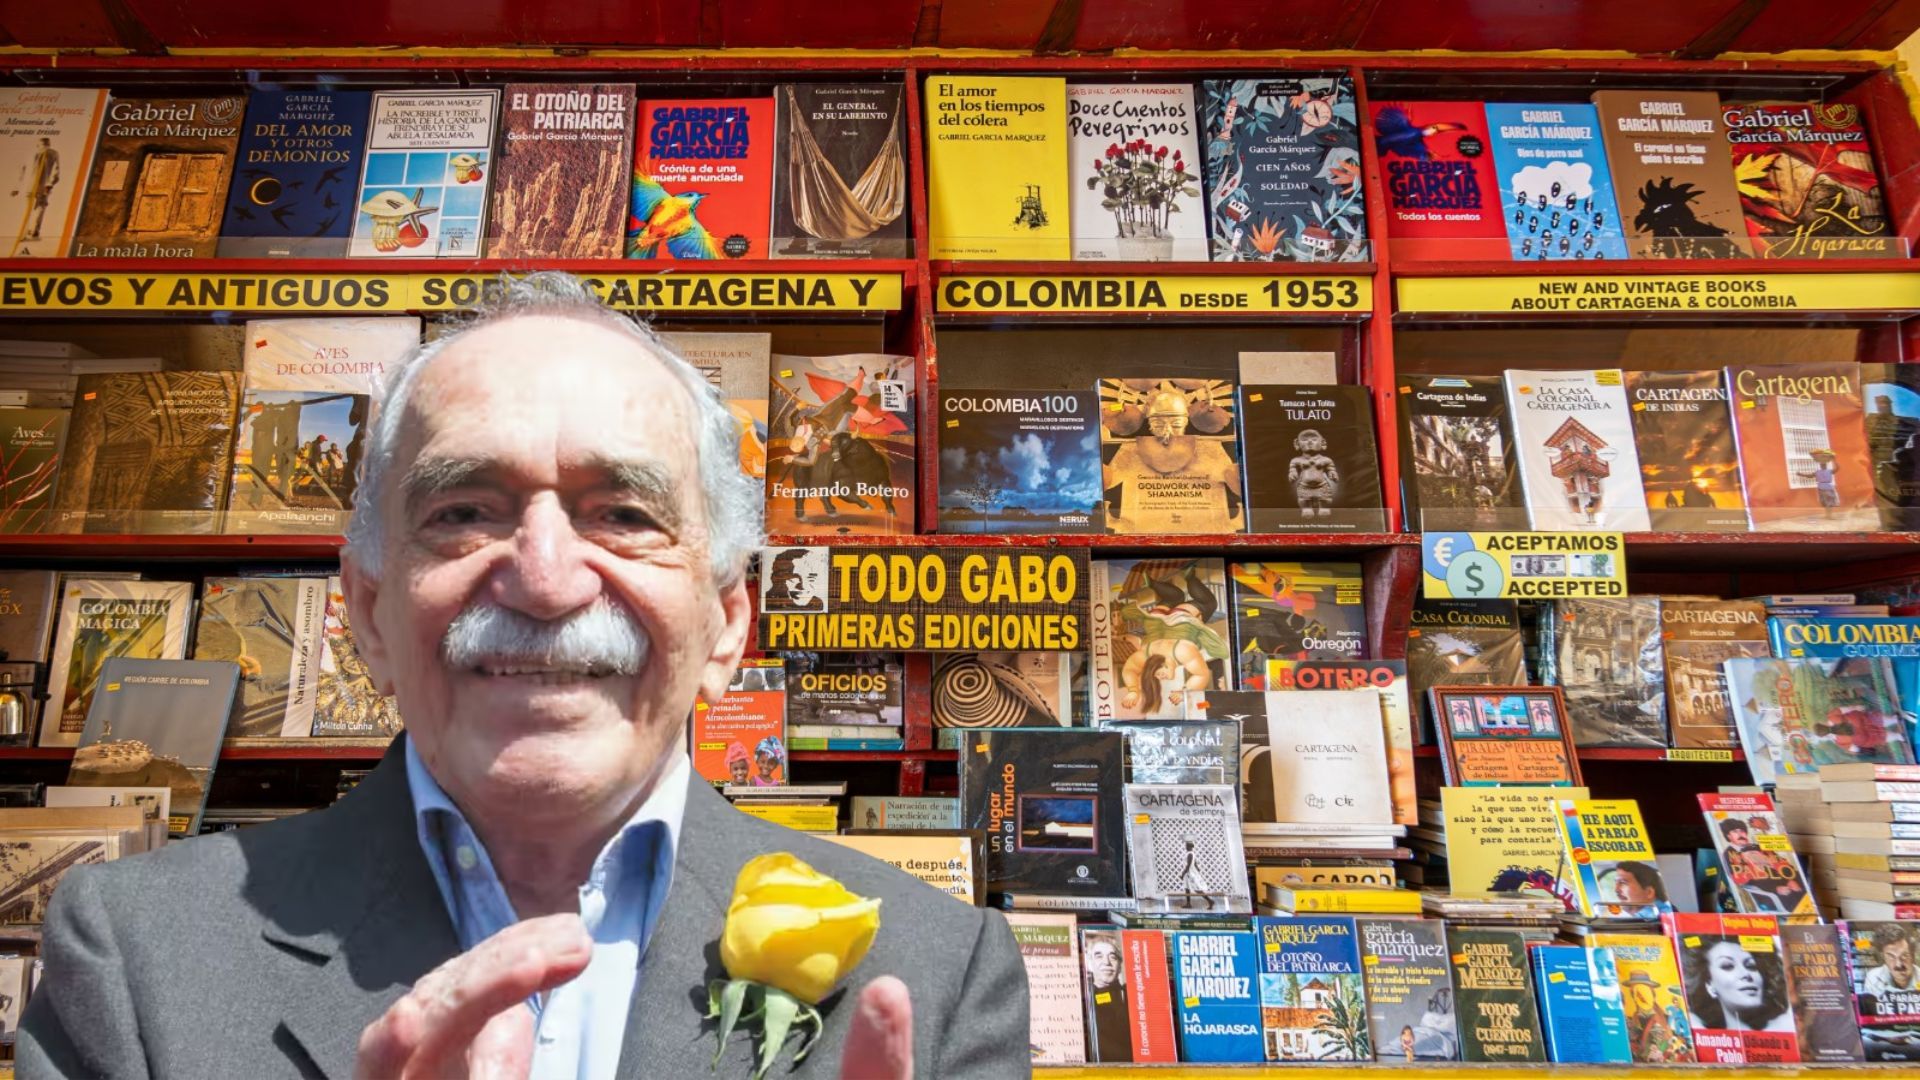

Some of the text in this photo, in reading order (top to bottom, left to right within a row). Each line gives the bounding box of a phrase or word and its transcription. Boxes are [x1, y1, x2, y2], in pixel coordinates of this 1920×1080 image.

[939, 84, 997, 97] El amor
[512, 90, 625, 111] EL OTOÑO DEL
[822, 102, 878, 111] EL GENERAL
[938, 100, 1045, 115] en los tiempos
[110, 104, 195, 121] Gabriel
[652, 107, 750, 122] GABRIEL
[1069, 99, 1187, 118] Doce Cuentos
[1640, 102, 1686, 116] GABRIEL
[533, 112, 625, 130] PATRIARCA
[812, 112, 888, 120] EN SU LABERINTO
[938, 113, 1008, 126] del cólera
[1521, 110, 1565, 123] GABRIEL
[1723, 109, 1812, 128] Gabriel
[106, 124, 237, 139] García Márquez
[255, 125, 354, 137] DEL AMOR
[650, 117, 750, 147] GARCÍA
[1069, 118, 1189, 144] Peregrinos
[1618, 117, 1714, 133] GARCÍA MÁRQUEZ
[1266, 136, 1298, 144] Gabriel
[1500, 125, 1593, 141] GARCÍA MÁRQUEZ
[1727, 129, 1863, 145] García Márquez
[271, 138, 334, 149] Y OTROS
[248, 150, 350, 163] DEMONIOS
[650, 144, 748, 159] MÁRQUEZ
[659, 164, 736, 174] Crónica de una
[1256, 162, 1311, 172] CIEN AÑOS
[1387, 161, 1477, 175] GABRIEL
[650, 173, 744, 183] muerte anunciada
[1389, 170, 1481, 198] GARCÍA
[1260, 182, 1309, 191] SOLEDAD
[1397, 212, 1481, 221] Todos los cuentos
[1815, 192, 1884, 235] La
[1765, 216, 1886, 259] Hojarasca
[77, 243, 195, 258] La mala hora
[128, 278, 157, 307] Y
[167, 278, 389, 307] ANTIGUOS
[582, 278, 836, 308] CARTAGENA
[848, 278, 879, 308] Y
[944, 279, 1359, 308] COLOMBIA DESDE 1953
[1539, 280, 1767, 295] NEW AND VINTAGE BOOKS
[1511, 295, 1797, 310] ABOUT CARTAGENA & COLOMBIA
[313, 347, 349, 360] AVES
[277, 361, 385, 376] DE COLOMBIA
[1539, 386, 1592, 396] LA CASA
[1737, 370, 1852, 404] Cartagena
[945, 396, 1078, 413] COLOMBIA100
[1417, 392, 1454, 404] Cartagena
[1455, 393, 1464, 402] de
[1465, 393, 1487, 402] Indias
[1536, 394, 1598, 403] COLONIAL
[1526, 401, 1612, 410] CARTAGENERA
[1645, 403, 1700, 411] DE INDIAS
[1285, 410, 1331, 421] TULATO
[771, 482, 910, 499] Fernando Botero
[1138, 482, 1211, 490] GOLDWORK AND
[1147, 490, 1203, 499] SHAMANISM
[1486, 536, 1619, 551] ACEPTAMOS
[833, 553, 1077, 603] TODO GABO
[1507, 581, 1622, 596] ACCEPTED
[81, 603, 169, 616] COLOMBIA
[79, 617, 141, 629] MAGICA
[1411, 610, 1510, 625] CASA COLONIAL
[1662, 610, 1760, 624] CARTAGENA
[769, 613, 1079, 649] PRIMERAS EDICIONES
[1301, 637, 1362, 652] Obregón
[1094, 602, 1111, 718] BOTERO
[801, 674, 887, 692] OFICIOS
[1280, 666, 1395, 690] BOTERO
[319, 720, 373, 730] Milton Cunha
[1295, 744, 1358, 753] CARTAGENA
[1458, 742, 1506, 754] PIRATAS
[1669, 750, 1731, 760] ARQUITECTURA
[1467, 764, 1508, 773] Cartagena
[1517, 764, 1559, 773] Cartagena
[1139, 793, 1224, 807] CARTAGENA
[1002, 763, 1015, 853] en el mundo
[887, 811, 929, 823] expedición
[938, 811, 948, 821] la
[988, 792, 1004, 852] un lugar
[1582, 814, 1634, 827] HE AQUI
[1586, 827, 1639, 839] A PABLO
[1480, 837, 1502, 846] para
[1588, 840, 1647, 853] ESCOBAR
[1731, 860, 1797, 881] PABLO
[1263, 925, 1349, 937] GABRIEL GARCIA
[1362, 923, 1392, 934] gabriel
[1366, 929, 1416, 944] garcía
[1804, 932, 1814, 943] EL
[1179, 935, 1238, 956] GABRIEL
[1463, 943, 1512, 956] GABRIEL
[1266, 950, 1322, 963] EL OTOÑO
[1467, 955, 1512, 968] GARCIA
[1804, 954, 1838, 965] PABLO
[1180, 956, 1236, 977] GARCIA
[1267, 962, 1352, 973] DEL PATRIARCA
[1794, 966, 1840, 977] ESCOBAR
[1459, 967, 1524, 989] MARQUEZ
[1181, 976, 1251, 1000] MARQUEZ
[1478, 1003, 1519, 1017] TODOS
[1183, 1013, 1201, 1023] LA
[1491, 1016, 1513, 1029] LOS
[1184, 1024, 1258, 1036] HOJARASCA
[1475, 1028, 1531, 1042] CUENTOS
[1696, 1032, 1741, 1046] Amando a
[1716, 1049, 1743, 1062] Pablo
